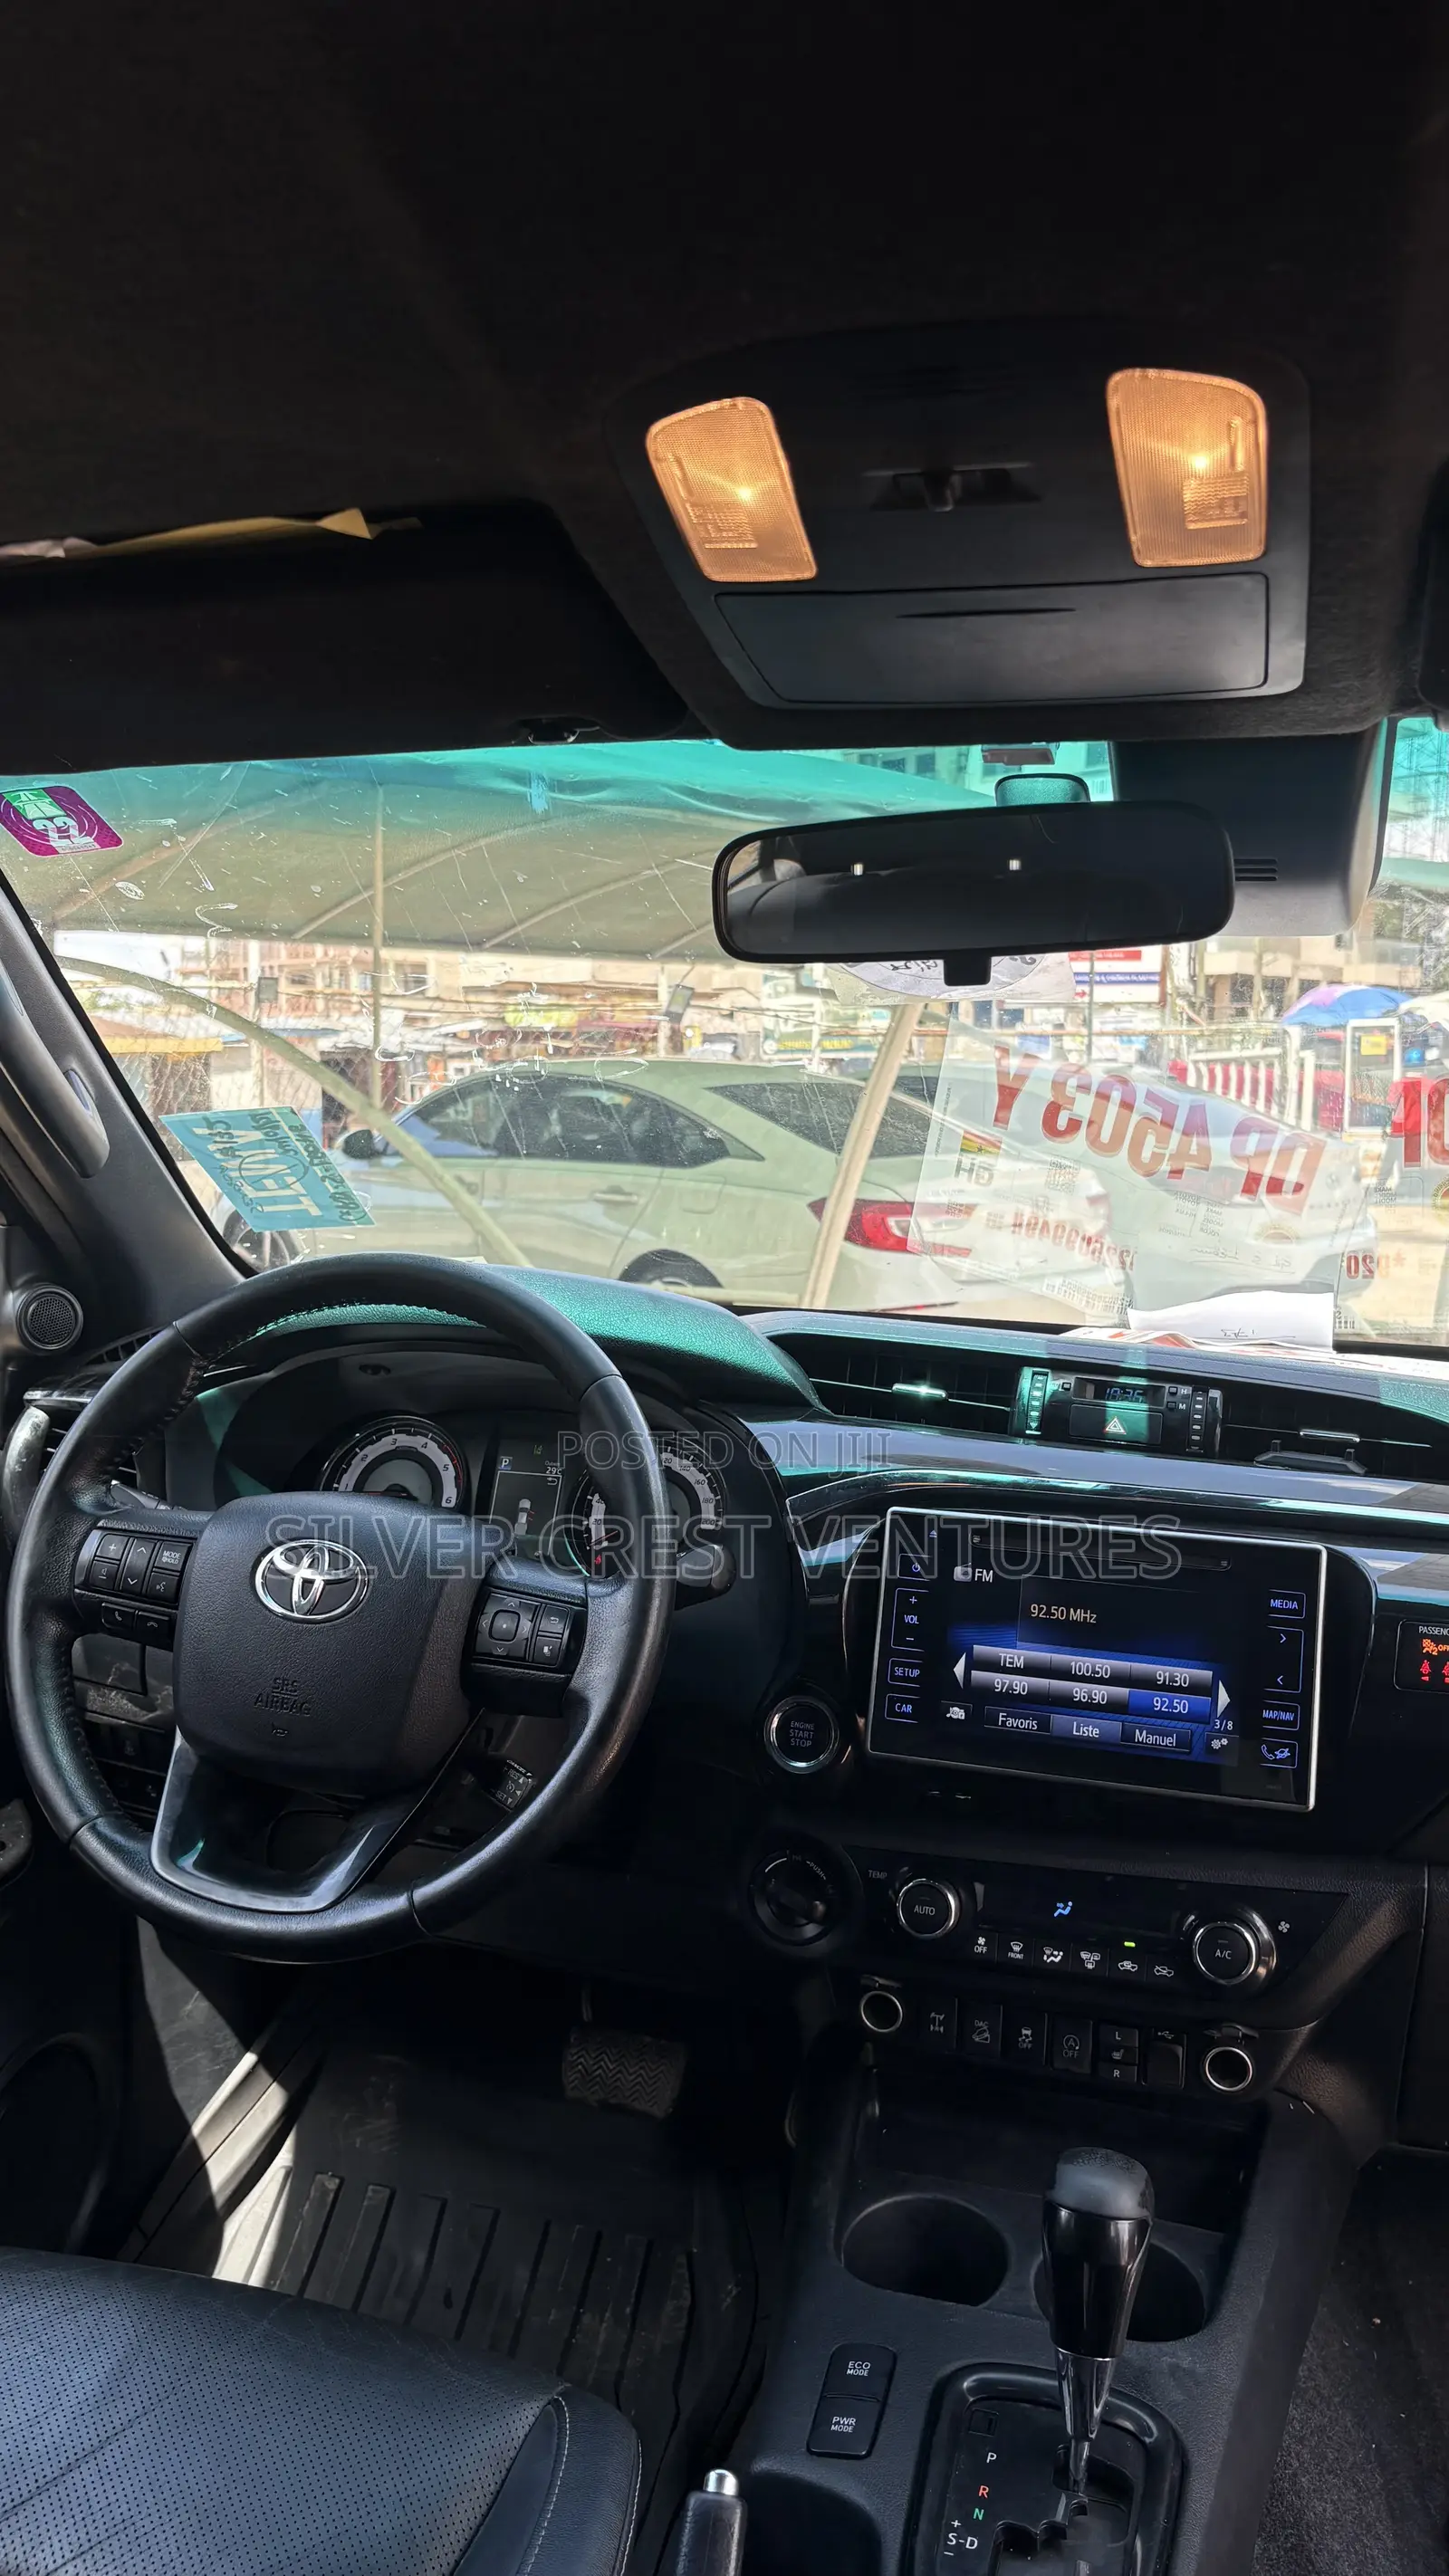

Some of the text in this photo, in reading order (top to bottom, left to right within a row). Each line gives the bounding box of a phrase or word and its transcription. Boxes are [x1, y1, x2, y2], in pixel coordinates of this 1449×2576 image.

[163, 1550, 181, 1559] MODE
[974, 1568, 994, 1583] FM
[1270, 1598, 1299, 1611] MEDIA
[904, 1614, 919, 1625] VOL
[1030, 1604, 1098, 1624] 92.50 MHz
[998, 1652, 1025, 1670] TEM
[894, 1666, 921, 1678] SETUP
[1070, 1661, 1111, 1679] 100.50
[272, 1676, 298, 1693] SRS
[1156, 1671, 1190, 1688] 91.30
[994, 1679, 1029, 1696] 97.90
[1072, 1687, 1108, 1705] 96.90
[254, 1692, 311, 1717] AIRBAG
[895, 1702, 913, 1714] CAR
[1153, 1697, 1189, 1714] 92.50
[998, 1712, 1039, 1730] Favoris
[1262, 1709, 1296, 1721] MAP/NAV
[791, 1720, 814, 1730] ENGINE
[1072, 1721, 1099, 1738] Liste
[1214, 1719, 1233, 1731] 3/8
[789, 1729, 815, 1739] START
[1134, 1729, 1177, 1748] Manuel
[791, 1738, 812, 1748] STOP
[868, 1869, 888, 1881] TEMP
[914, 1904, 936, 1917] AUTO
[974, 1945, 988, 1954] OFF
[1007, 1951, 1024, 1960] FRONT
[1214, 1949, 1233, 1960] A/C
[974, 2019, 989, 2028] DAC
[1018, 2042, 1033, 2050] OFF
[1062, 2049, 1080, 2059] OFF
[848, 2361, 871, 2370] ECO
[846, 2368, 869, 2377] MODE
[831, 2416, 857, 2427] PWR
[830, 2424, 854, 2433] MODE
[986, 2451, 997, 2463] P
[978, 2485, 989, 2498] R
[973, 2507, 984, 2521] N
